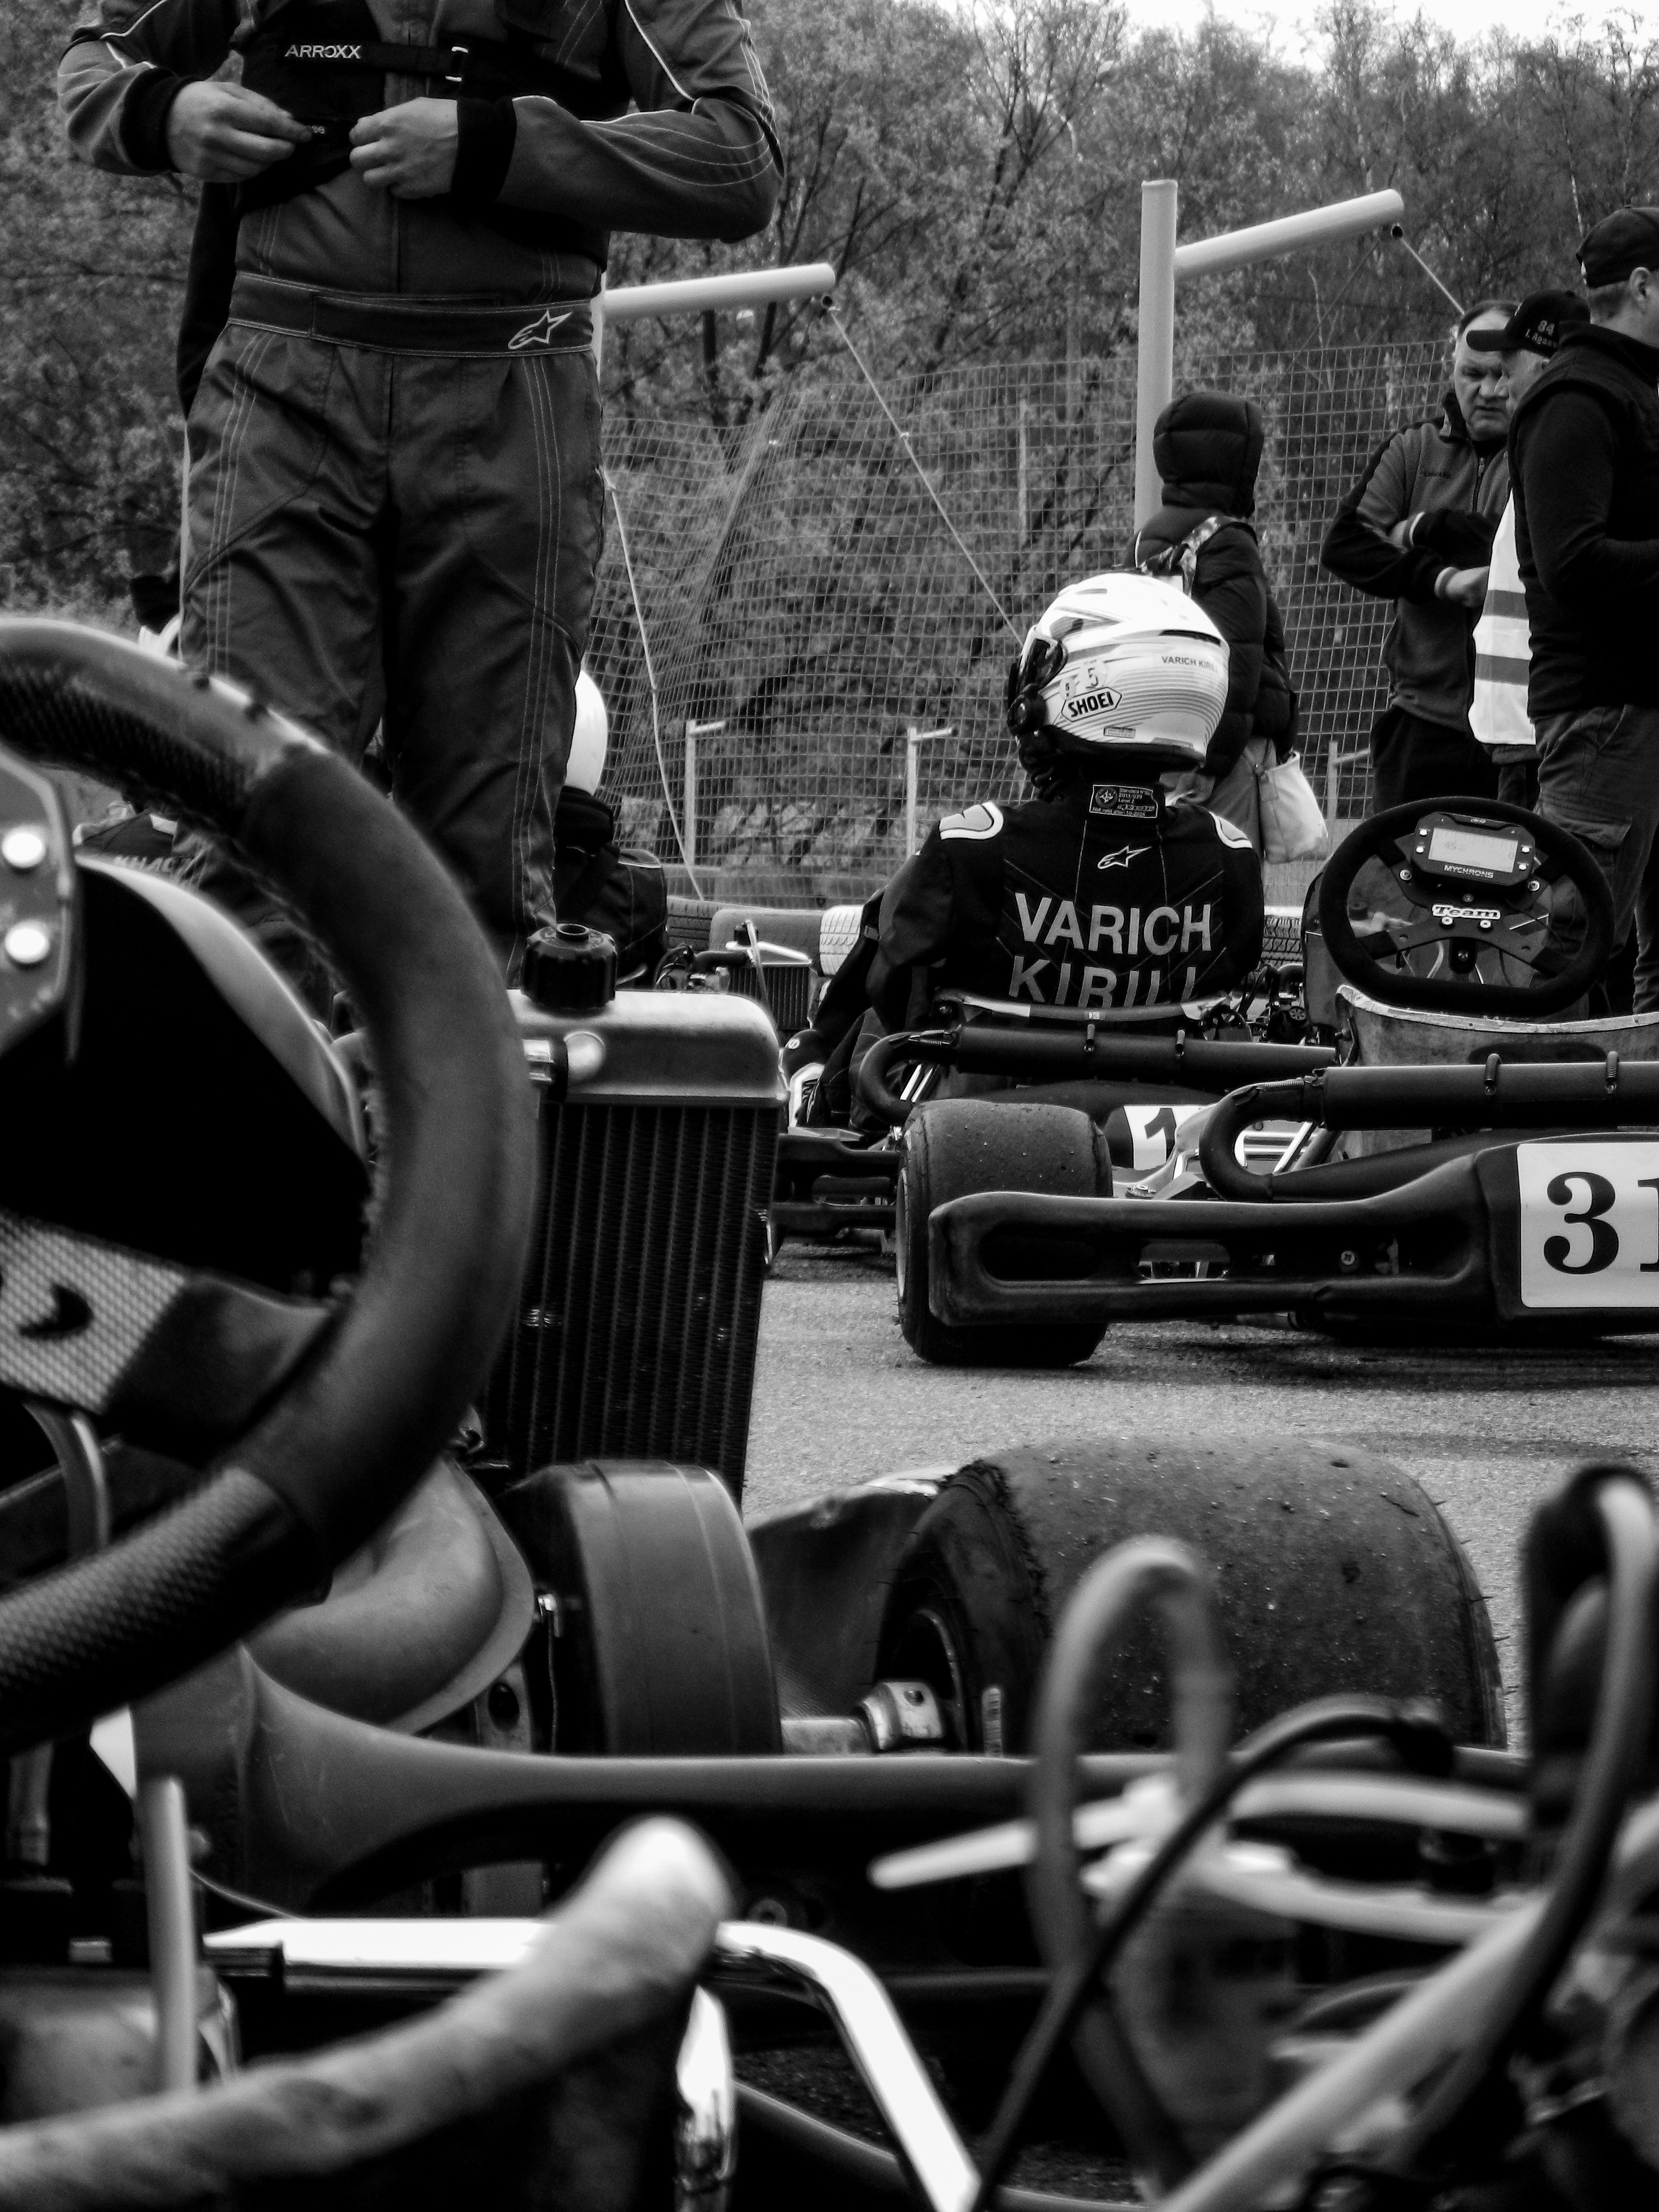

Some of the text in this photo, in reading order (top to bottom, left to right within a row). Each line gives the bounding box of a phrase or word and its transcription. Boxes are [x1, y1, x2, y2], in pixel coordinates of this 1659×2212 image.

[1161, 656, 1196, 666] VARICH
[1068, 692, 1114, 717] SHOEI
[1433, 905, 1500, 919] Team
[1015, 892, 1211, 955] VARICH
